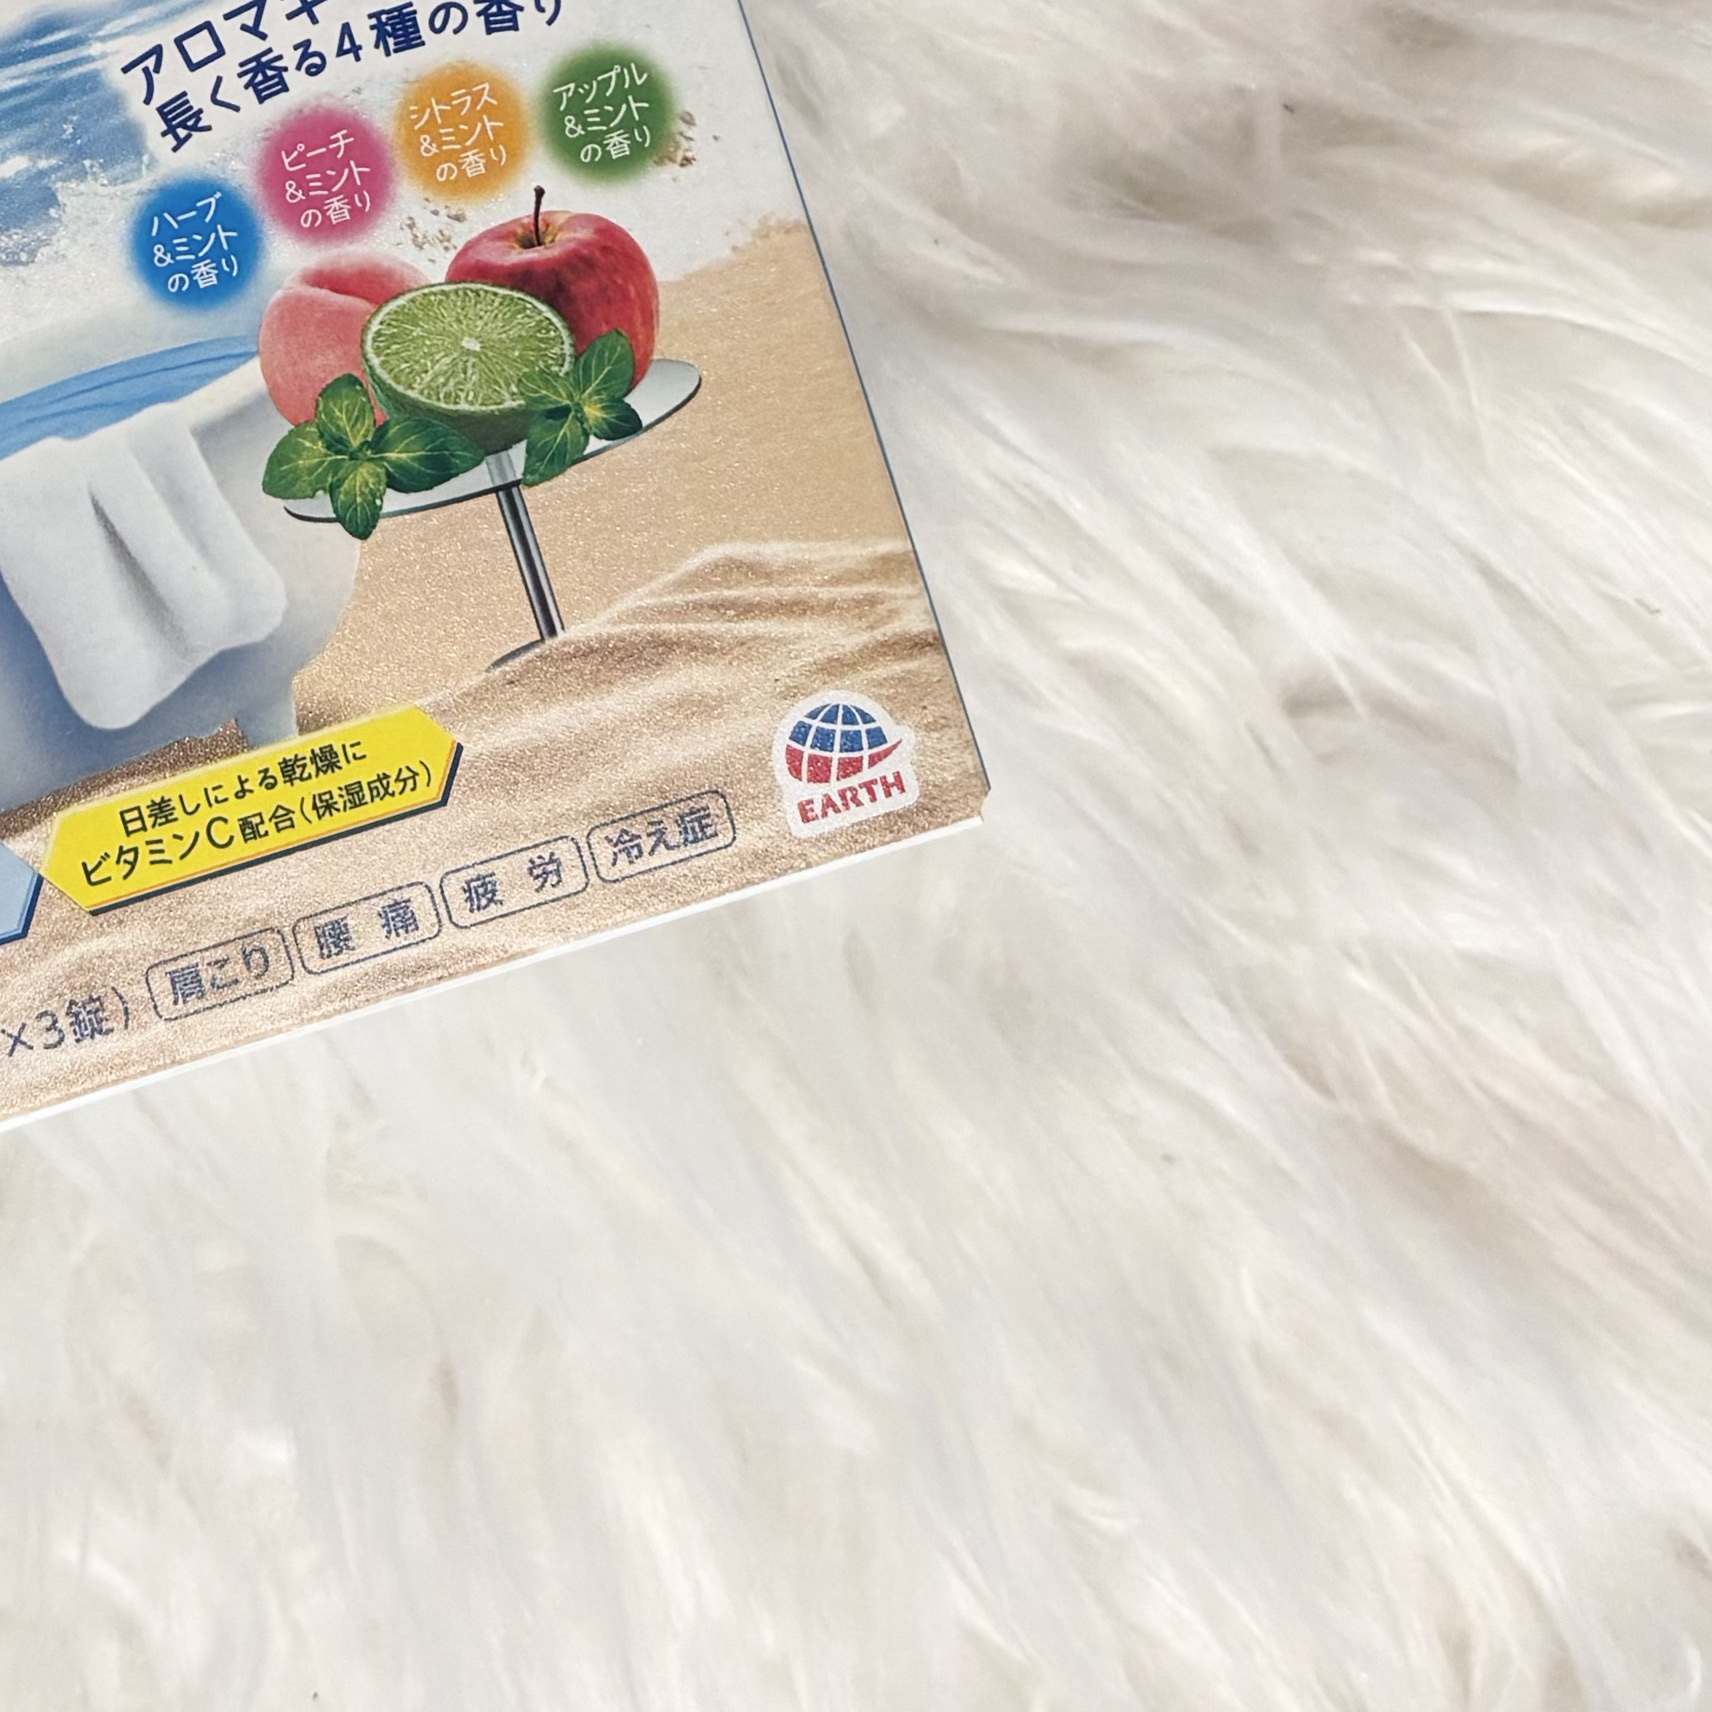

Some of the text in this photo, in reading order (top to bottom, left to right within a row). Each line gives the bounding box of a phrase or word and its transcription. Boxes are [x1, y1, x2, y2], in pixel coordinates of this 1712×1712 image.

[409, 83, 497, 130] シトラス
[553, 63, 648, 111] アップル
[420, 115, 504, 157] &ミント
[564, 95, 649, 138] &ミント
[281, 130, 354, 171] ピーチ
[436, 145, 506, 182] の香り
[580, 126, 650, 162] の香り
[285, 160, 370, 203] &ミント
[152, 191, 222, 236] ハーブ
[300, 191, 371, 228] の香り
[154, 224, 237, 267] &ミント
[167, 255, 238, 293] の香り
[119, 741, 367, 837] 日差しによる乾燥に
[797, 771, 906, 824] EARTH
[606, 807, 720, 868] 冷え症
[165, 943, 270, 1006] 肩こり
